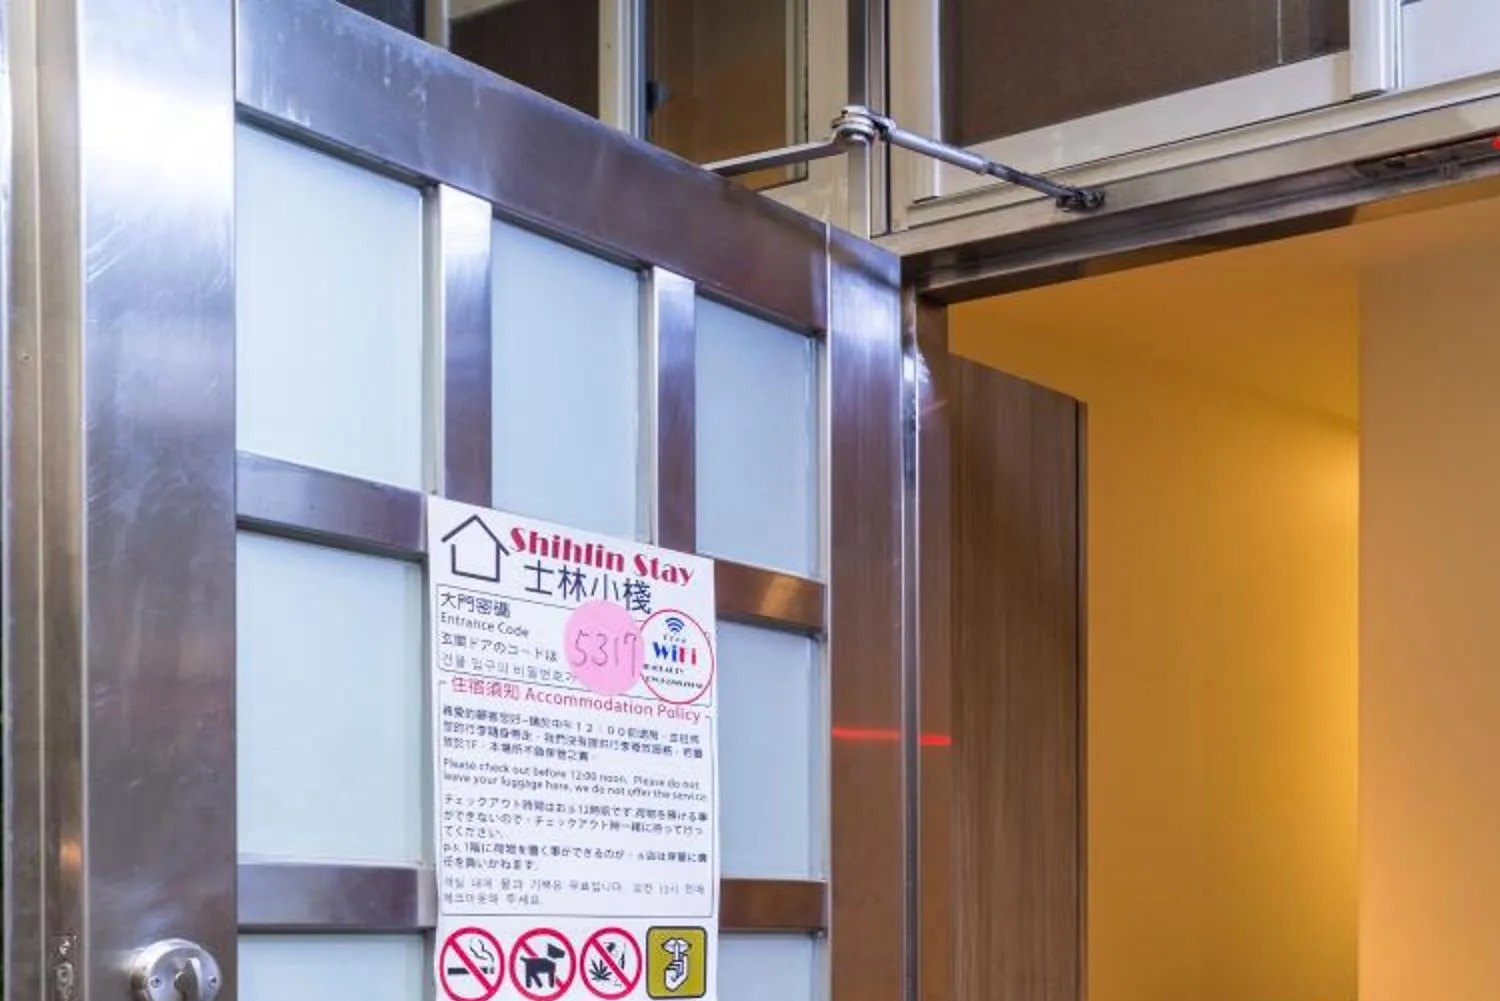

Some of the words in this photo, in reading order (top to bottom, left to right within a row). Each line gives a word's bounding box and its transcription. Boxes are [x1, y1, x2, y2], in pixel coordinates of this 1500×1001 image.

[509, 526, 625, 573] Shihlin
[632, 553, 695, 587] Stay
[523, 559, 651, 615] 士林小棧
[440, 592, 511, 618] 大門密碼
[441, 611, 495, 632] Entrance
[497, 621, 529, 637] Code
[571, 629, 637, 678] 5317
[451, 676, 520, 701] 住宿須知
[525, 688, 654, 716] Accommodation
[656, 704, 702, 725] Policy
[575, 784, 589, 792] we
[592, 784, 604, 794] do
[607, 786, 625, 795] not
[627, 787, 651, 797] offer
[653, 788, 670, 799] the
[633, 775, 665, 787] Please
